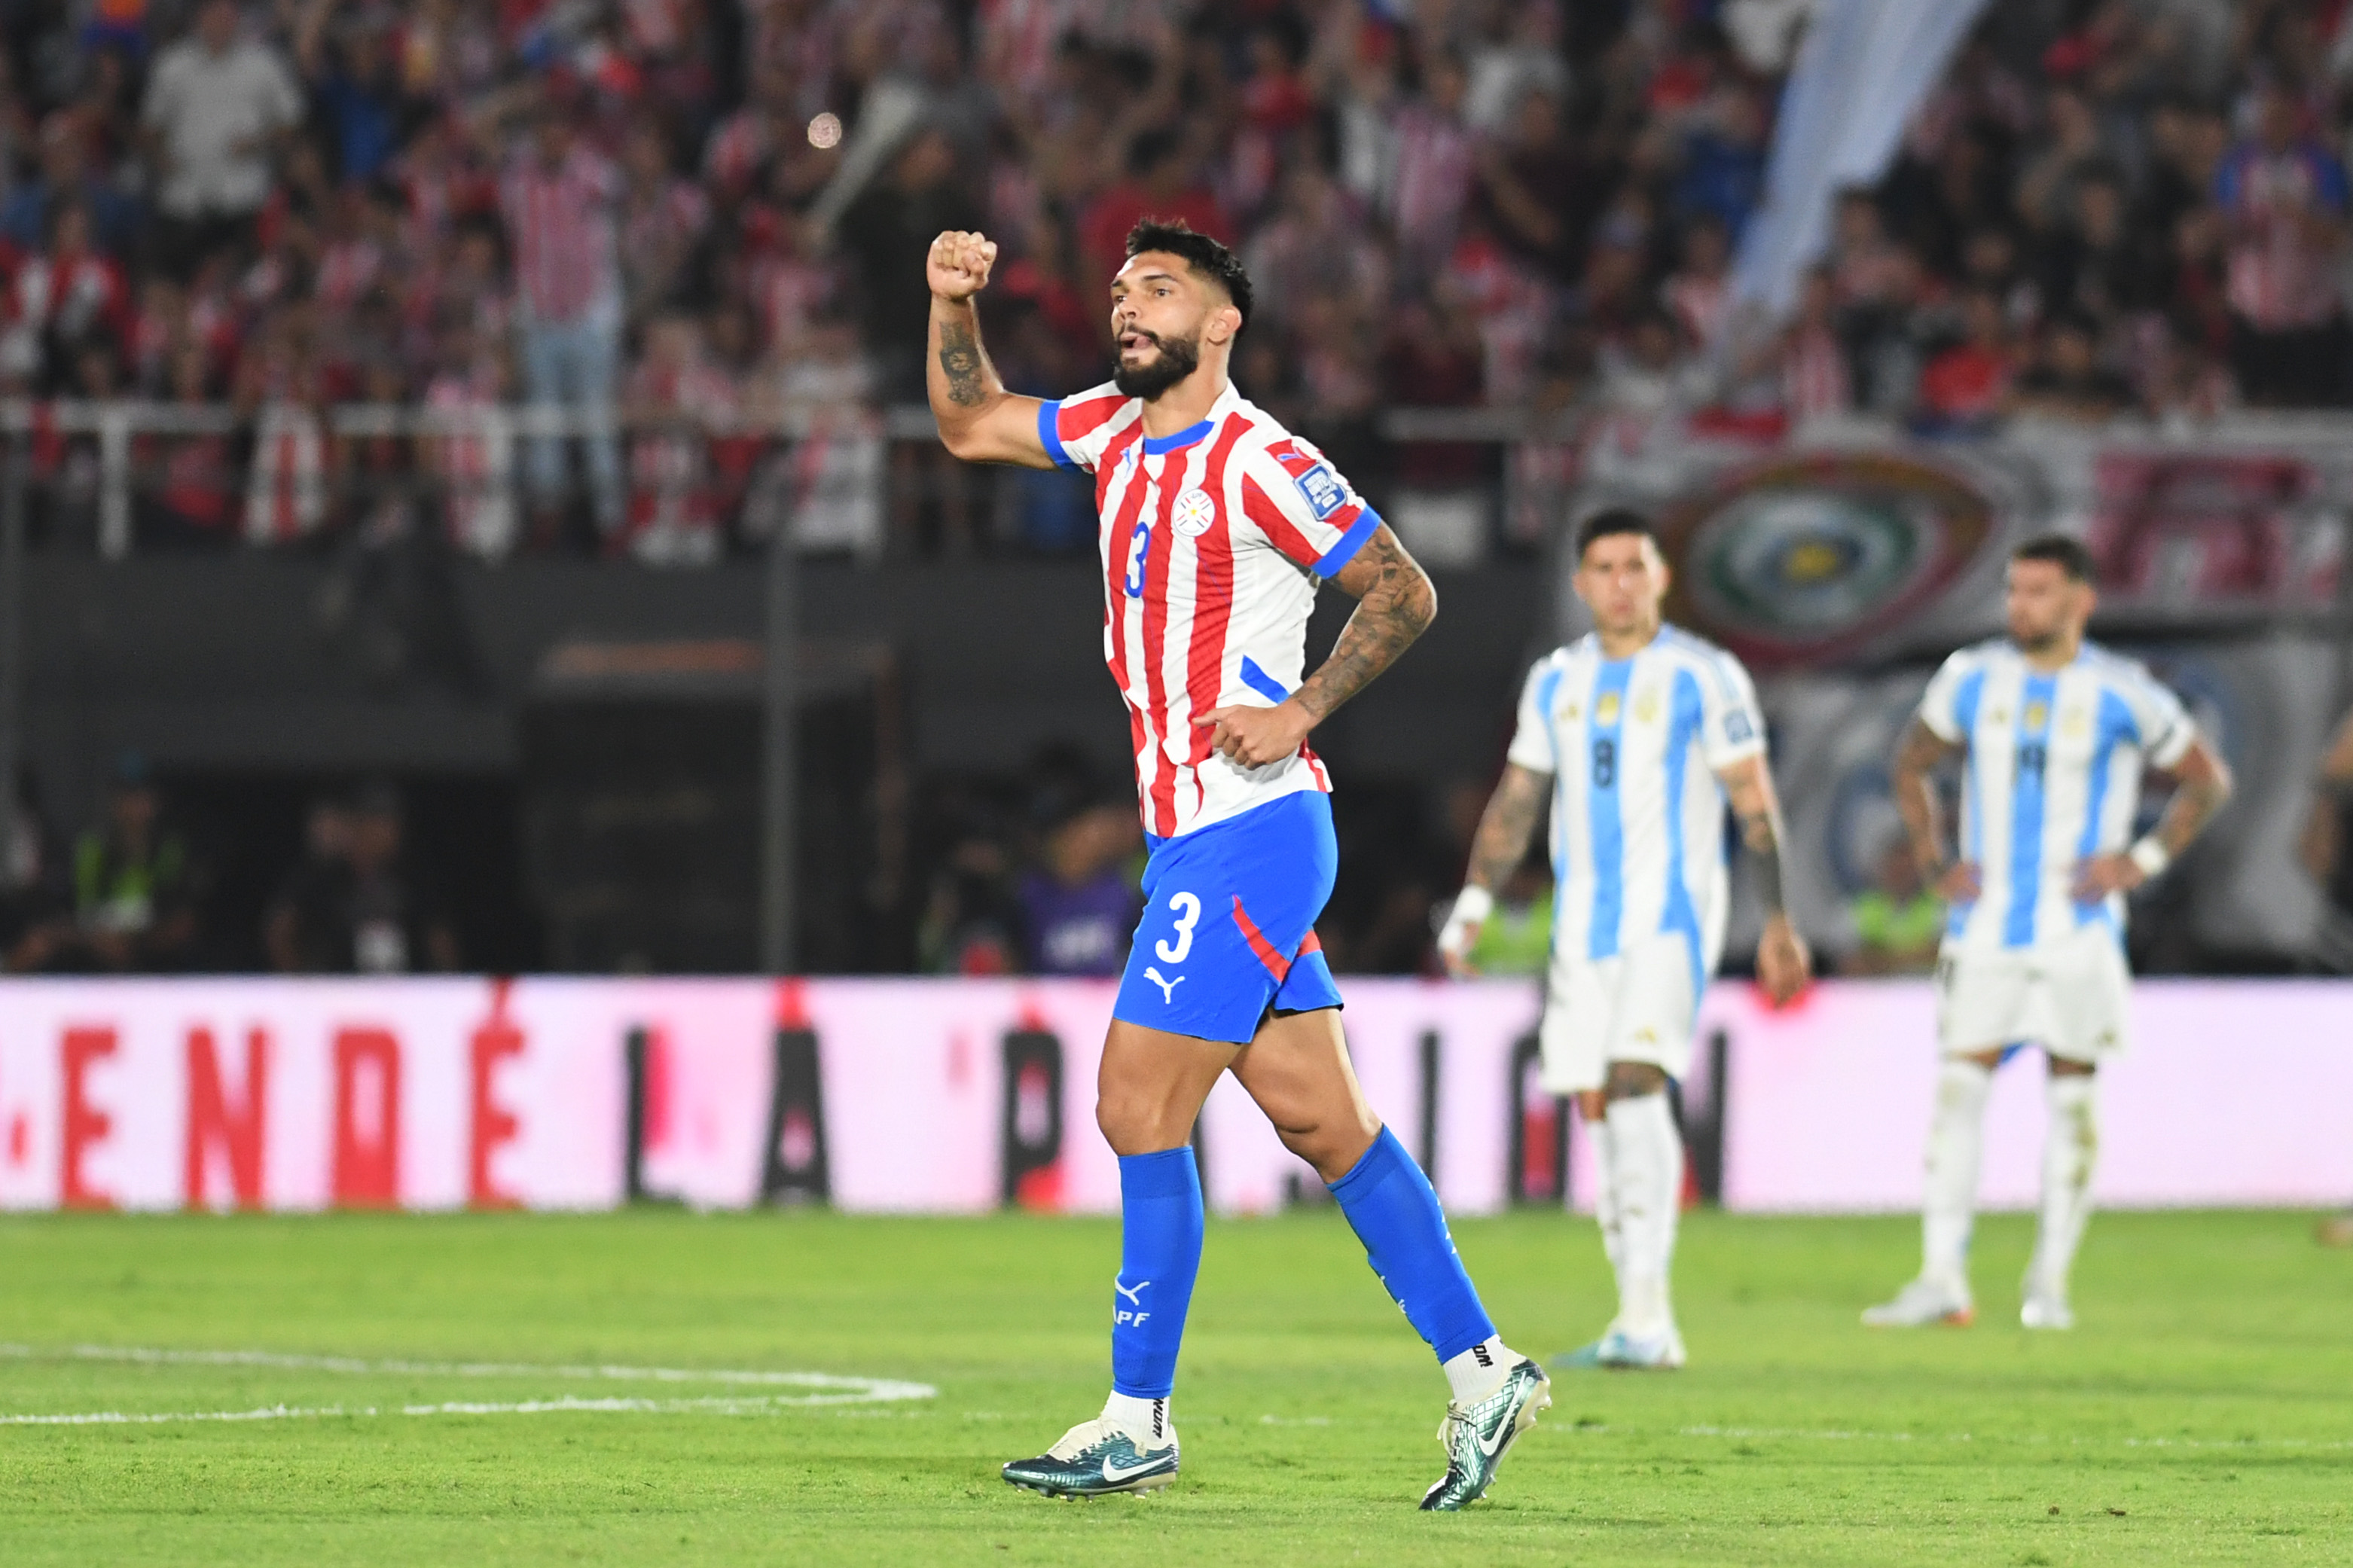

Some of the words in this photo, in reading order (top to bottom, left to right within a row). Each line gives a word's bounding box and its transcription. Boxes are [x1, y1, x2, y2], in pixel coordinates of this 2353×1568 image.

[1125, 520, 1151, 598] 3
[1592, 738, 1617, 791] 8
[1155, 891, 1201, 964] 3
